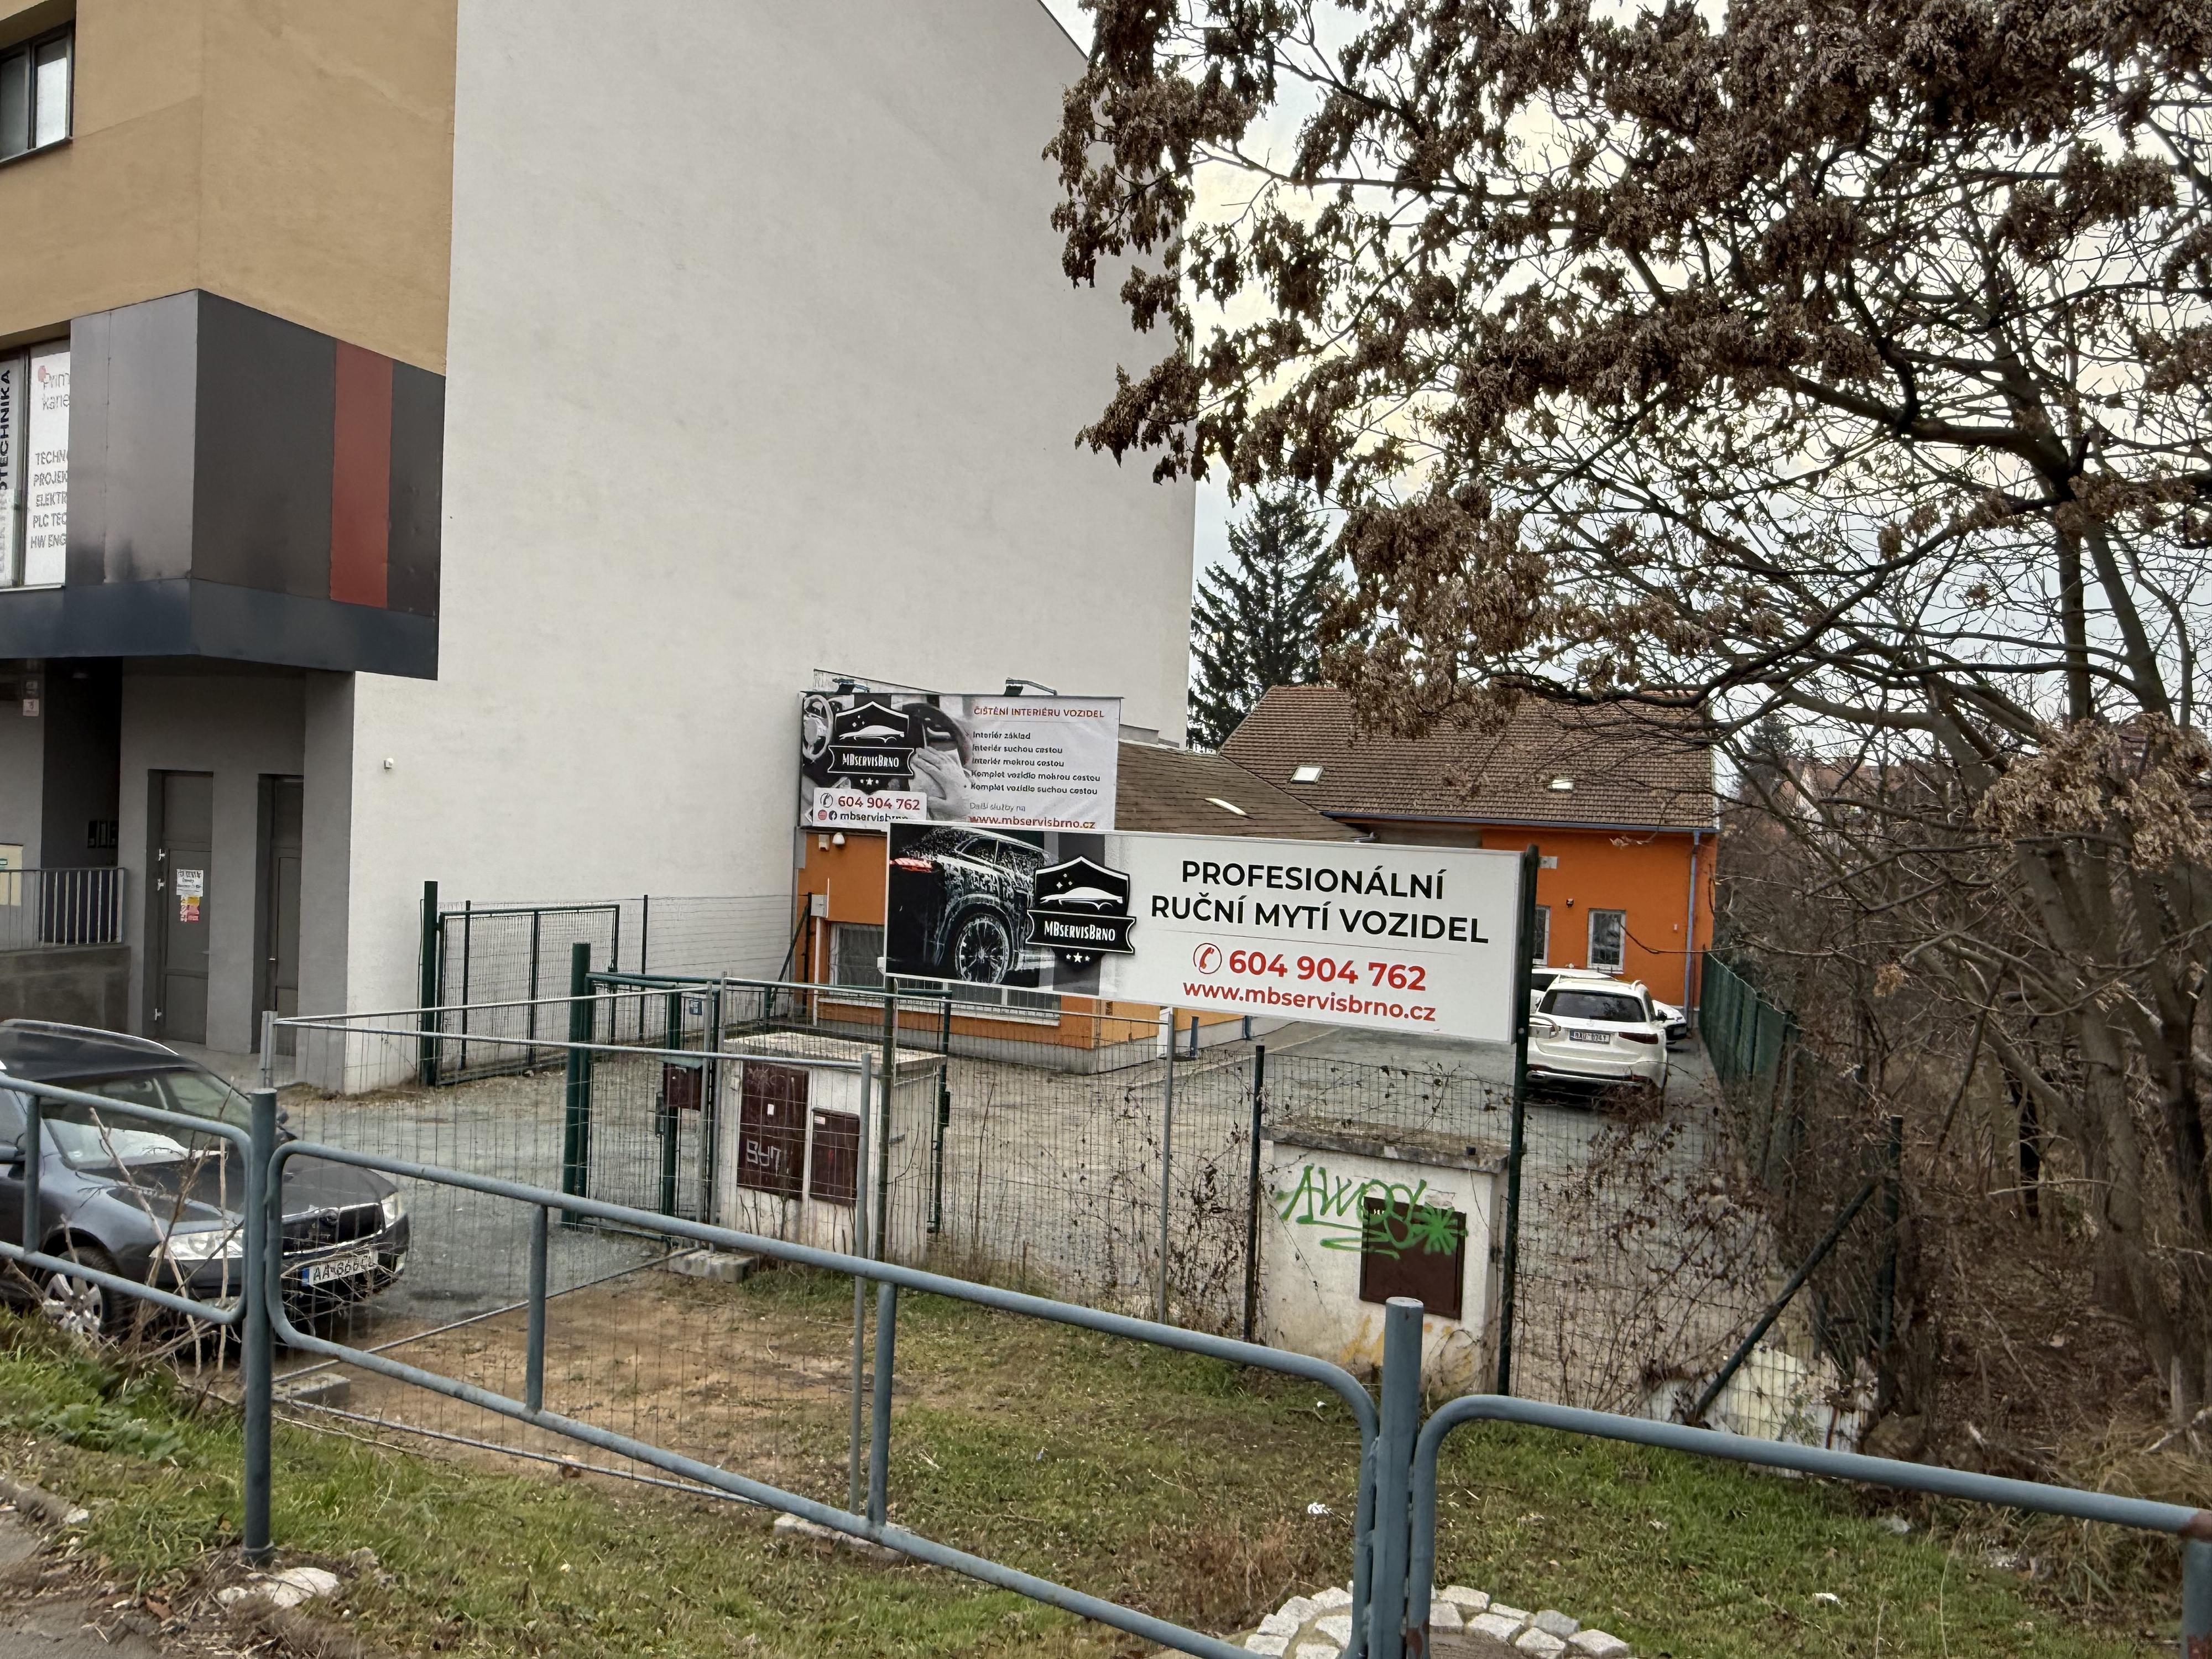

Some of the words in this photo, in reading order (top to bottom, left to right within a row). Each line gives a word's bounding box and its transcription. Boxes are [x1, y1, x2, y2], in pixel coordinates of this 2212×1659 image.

[974, 706, 1009, 716] ČIŠTĚNÍ
[1011, 707, 1060, 717] INTERIÉRU
[1063, 709, 1104, 718] VOZIDEL
[1003, 758, 1035, 766] mokrou
[1038, 773, 1071, 781] mokrou
[1037, 785, 1067, 794] suchou
[838, 796, 863, 807] 604
[867, 797, 893, 809] 904
[896, 799, 920, 810] 762
[968, 816, 1096, 829] www.mbservisbrno.cz
[1182, 860, 1447, 901] PROFESIONÁLNÍ
[1151, 892, 1247, 925] RUČNÍ
[1255, 901, 1331, 931] MYTÍ
[1339, 908, 1489, 944] VOZIDEL
[1229, 950, 1288, 978] 604
[1296, 955, 1359, 985] 904
[1368, 962, 1427, 992] 762
[1182, 982, 1437, 1022] www.mbservisbrno.cz
